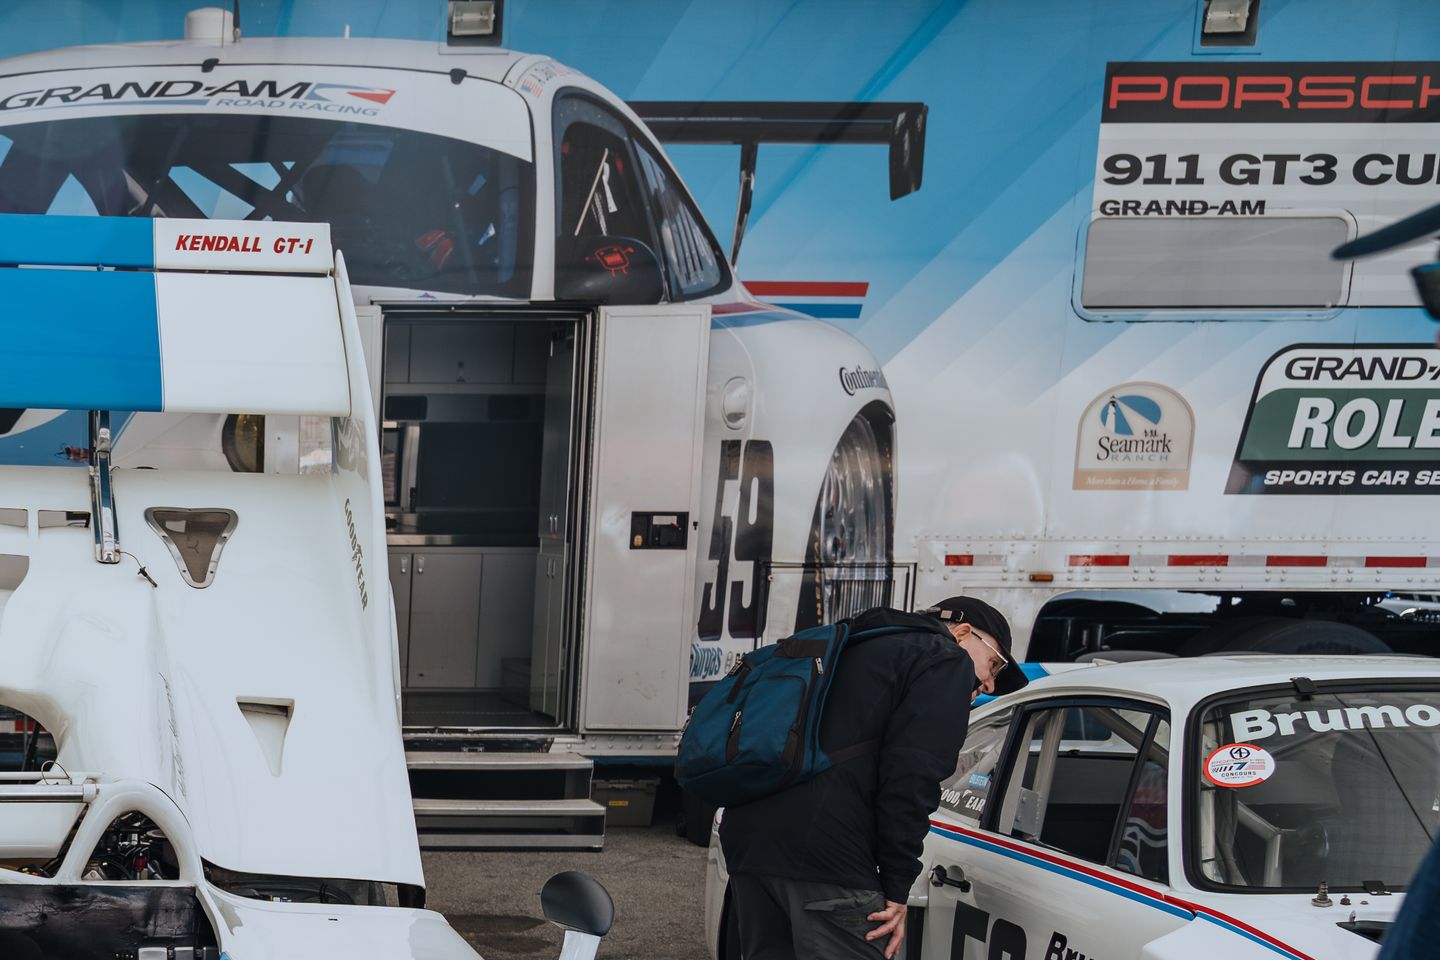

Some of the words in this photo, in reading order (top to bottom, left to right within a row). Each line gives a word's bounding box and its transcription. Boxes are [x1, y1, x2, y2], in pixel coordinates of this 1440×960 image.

[216, 98, 287, 110] ROAD
[289, 102, 381, 117] RACING
[1102, 153, 1205, 186] 911
[1218, 153, 1338, 186] GT3
[1352, 153, 1440, 186] CU
[1099, 200, 1266, 216] GRAND-AM
[174, 234, 262, 252] KENDALL
[272, 236, 313, 254] GT-1
[1284, 357, 1440, 381] GRAND-
[1097, 433, 1172, 461] Seamark
[1263, 470, 1356, 486] SPORTS
[1361, 470, 1409, 486] CAR
[697, 439, 774, 640] 59
[344, 498, 368, 611] GOODYEAR
